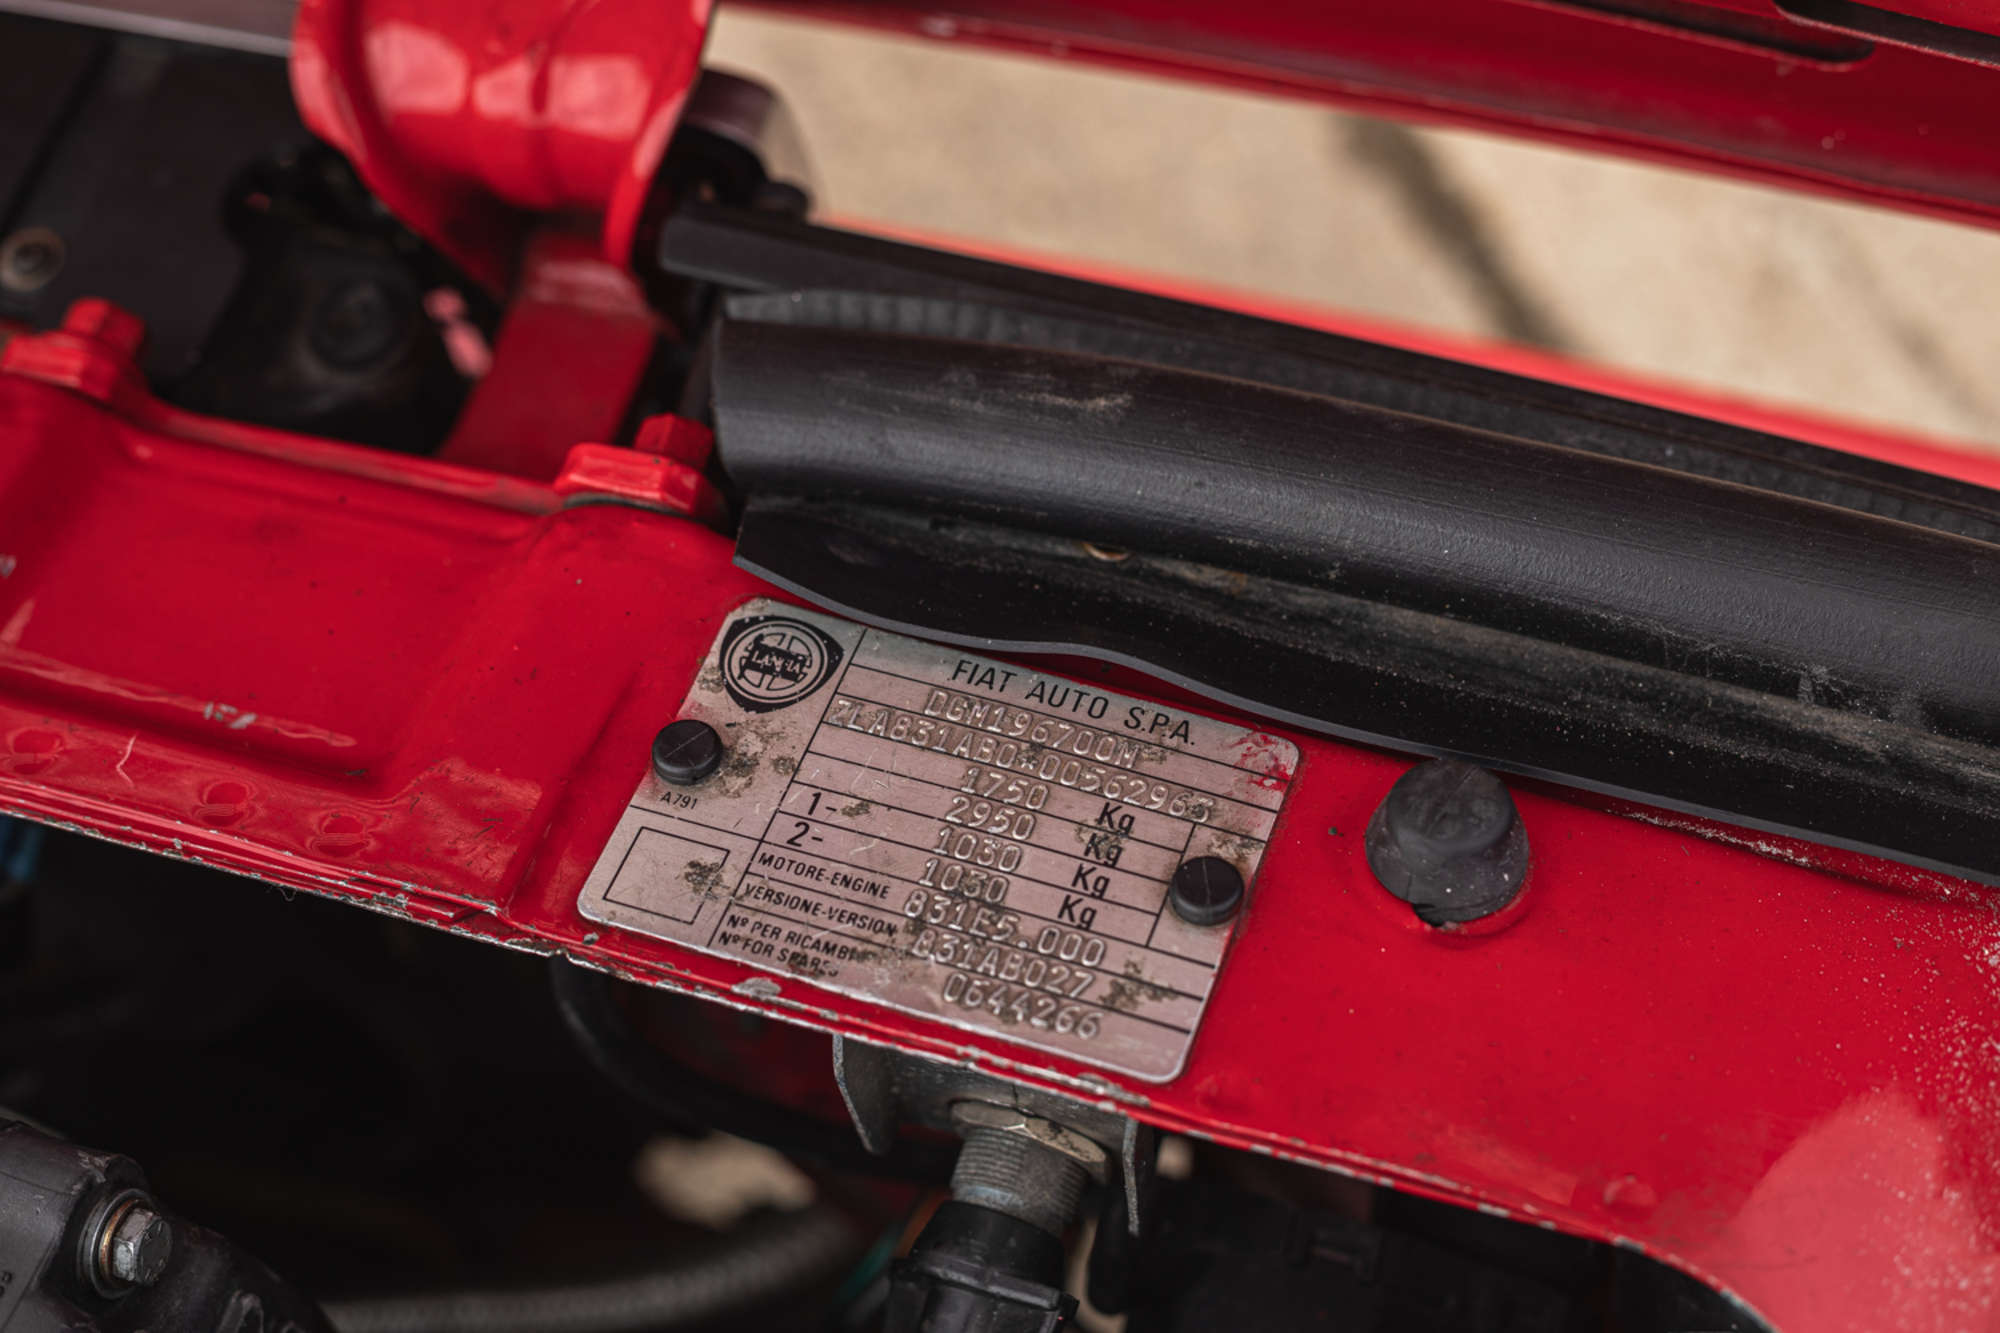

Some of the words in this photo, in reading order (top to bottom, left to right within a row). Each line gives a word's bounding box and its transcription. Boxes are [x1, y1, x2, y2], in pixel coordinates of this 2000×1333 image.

[752, 651, 800, 673] LANIA
[952, 659, 1017, 693] FIAT
[1025, 680, 1109, 719] AUTO
[1124, 706, 1195, 746] S.P.A.
[661, 792, 698, 809] A791
[961, 767, 1049, 810] 1750
[1098, 802, 1135, 836] Kg
[946, 796, 1036, 840] 2950
[1084, 833, 1123, 868] Kg
[758, 852, 891, 900] MOTORE-ENGINE
[933, 827, 1022, 872] 1030
[1072, 863, 1110, 900] Kg
[744, 883, 898, 937] VERSIONE-VERSION
[751, 922, 782, 940] PER
[1058, 895, 1097, 930] Kg
[742, 938, 775, 957] FOR
